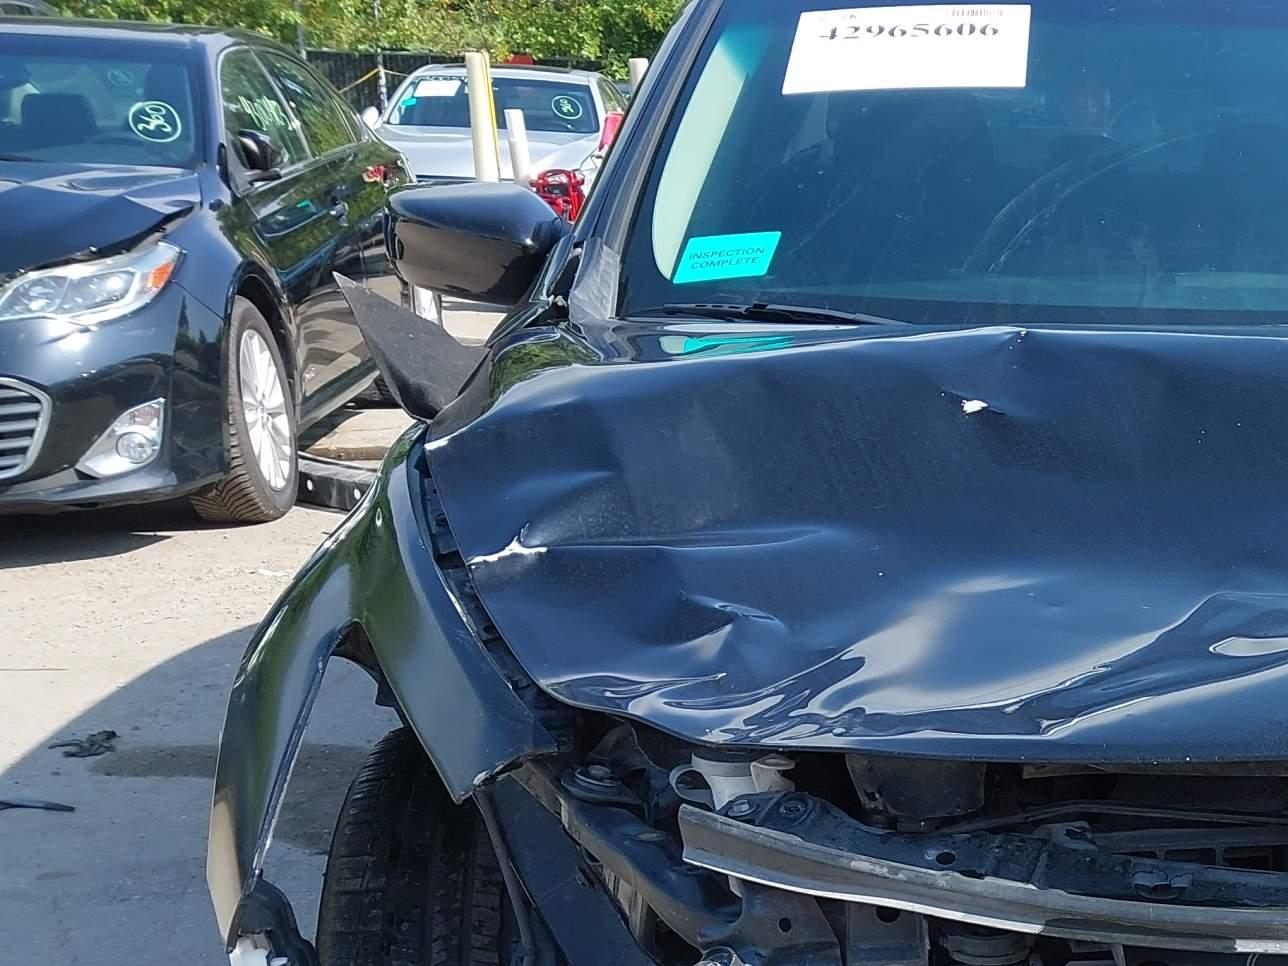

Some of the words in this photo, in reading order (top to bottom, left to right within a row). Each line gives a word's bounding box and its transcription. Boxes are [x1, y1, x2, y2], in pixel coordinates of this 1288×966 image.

[819, 23, 999, 40] 42965606
[689, 247, 765, 260] INSPECTION
[691, 257, 759, 269] COMPLETE
